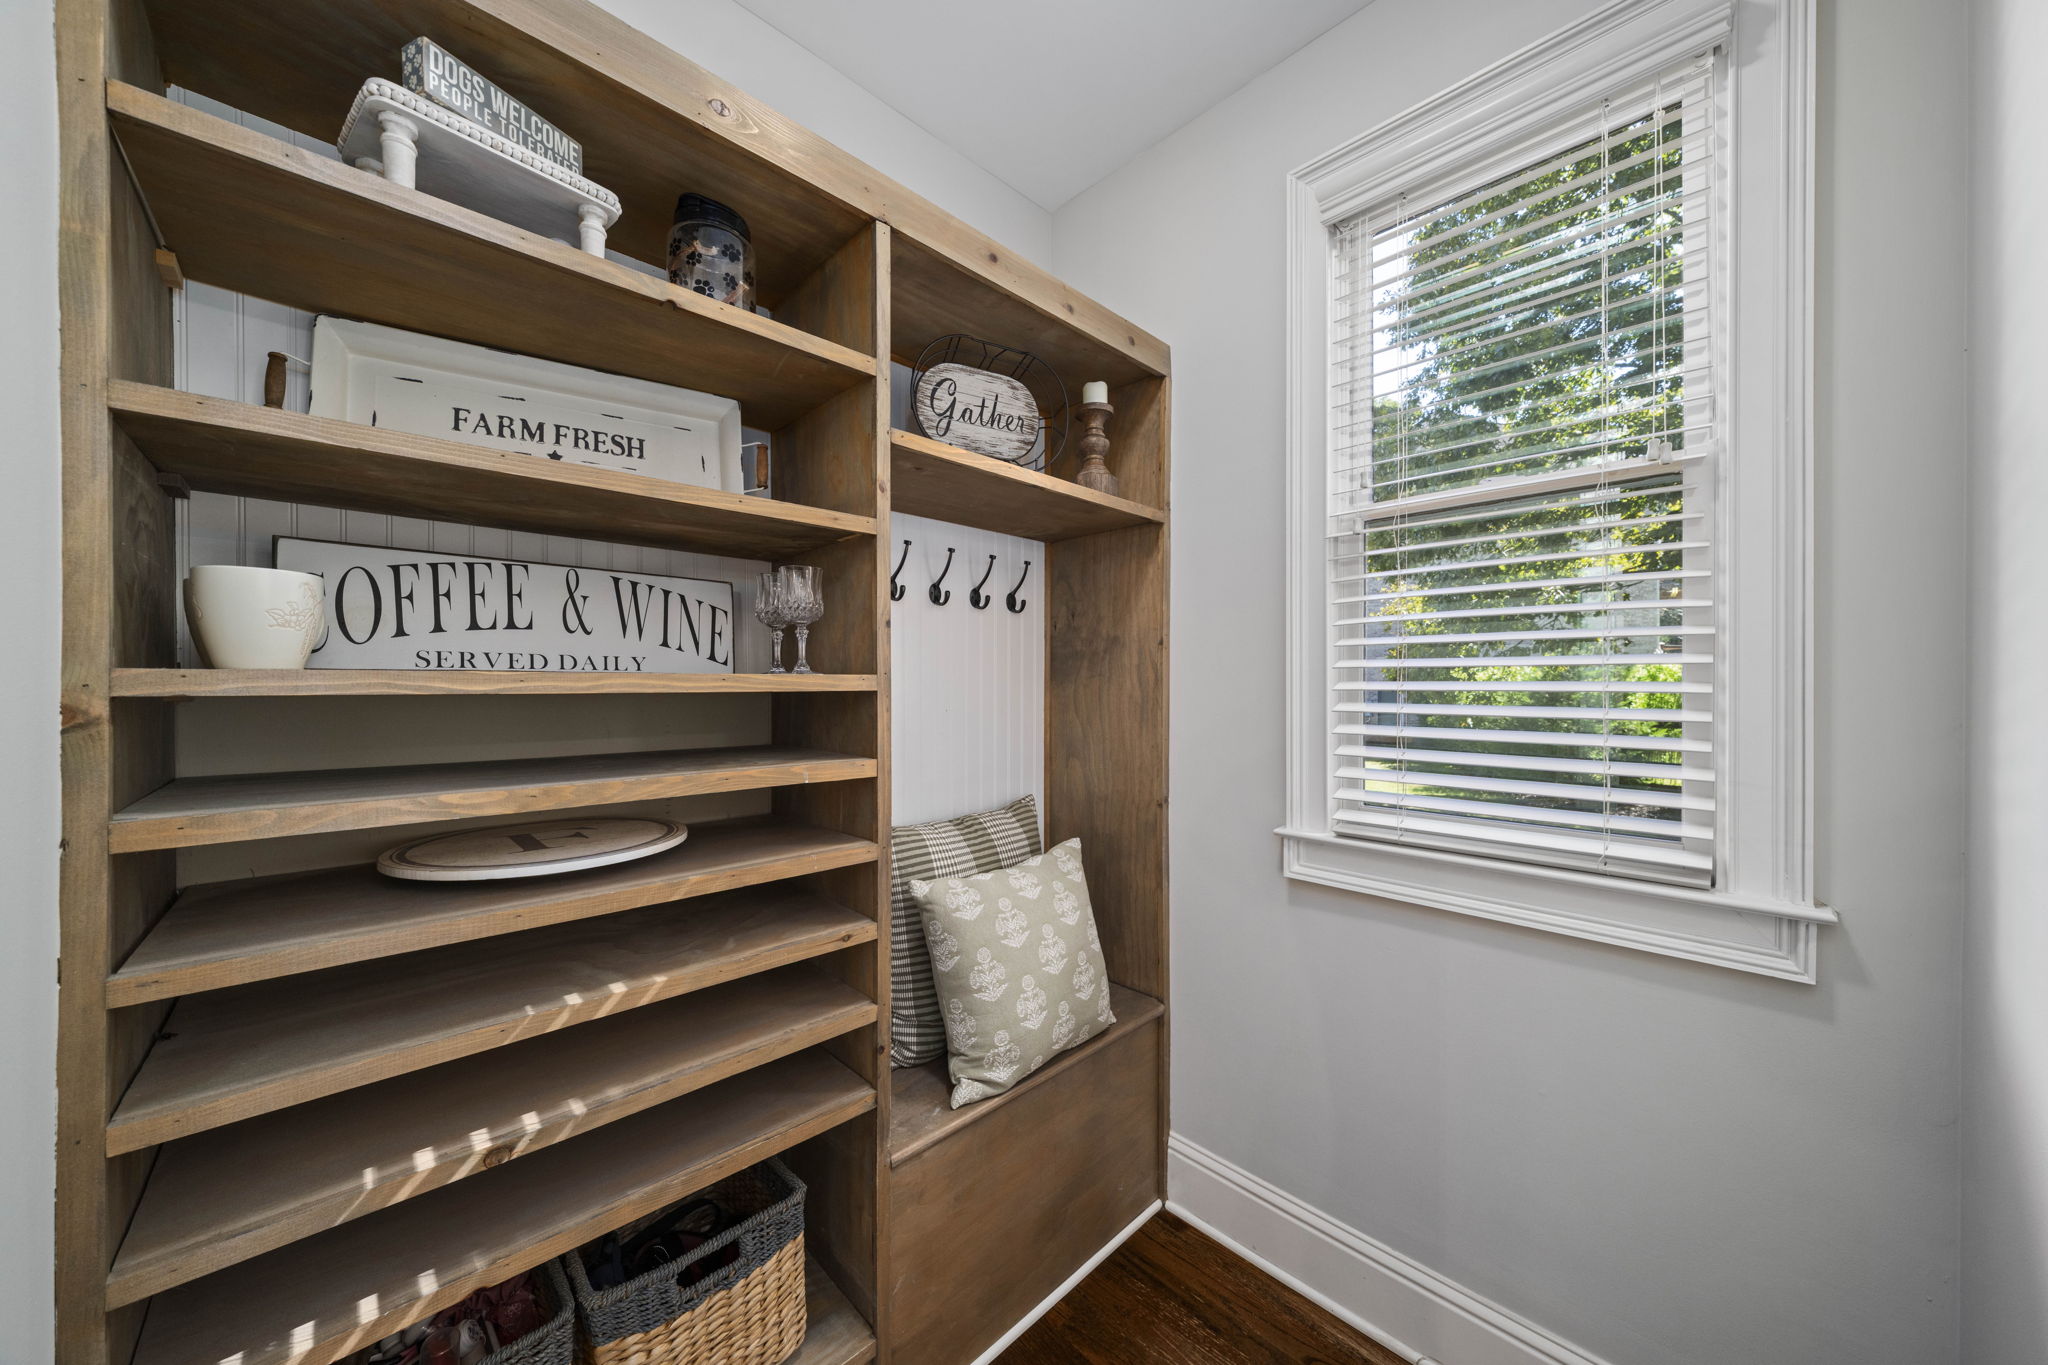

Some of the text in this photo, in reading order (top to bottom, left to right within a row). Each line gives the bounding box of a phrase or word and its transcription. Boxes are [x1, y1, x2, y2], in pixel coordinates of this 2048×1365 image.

[429, 73, 493, 127] PEOPLE
[429, 44, 579, 167] DOGS WELCOME
[452, 407, 646, 460] FARM FRESH
[930, 377, 1025, 437] Gather
[562, 568, 593, 636] &
[609, 575, 729, 666] WINE
[415, 650, 647, 672] SERVED DAILY
